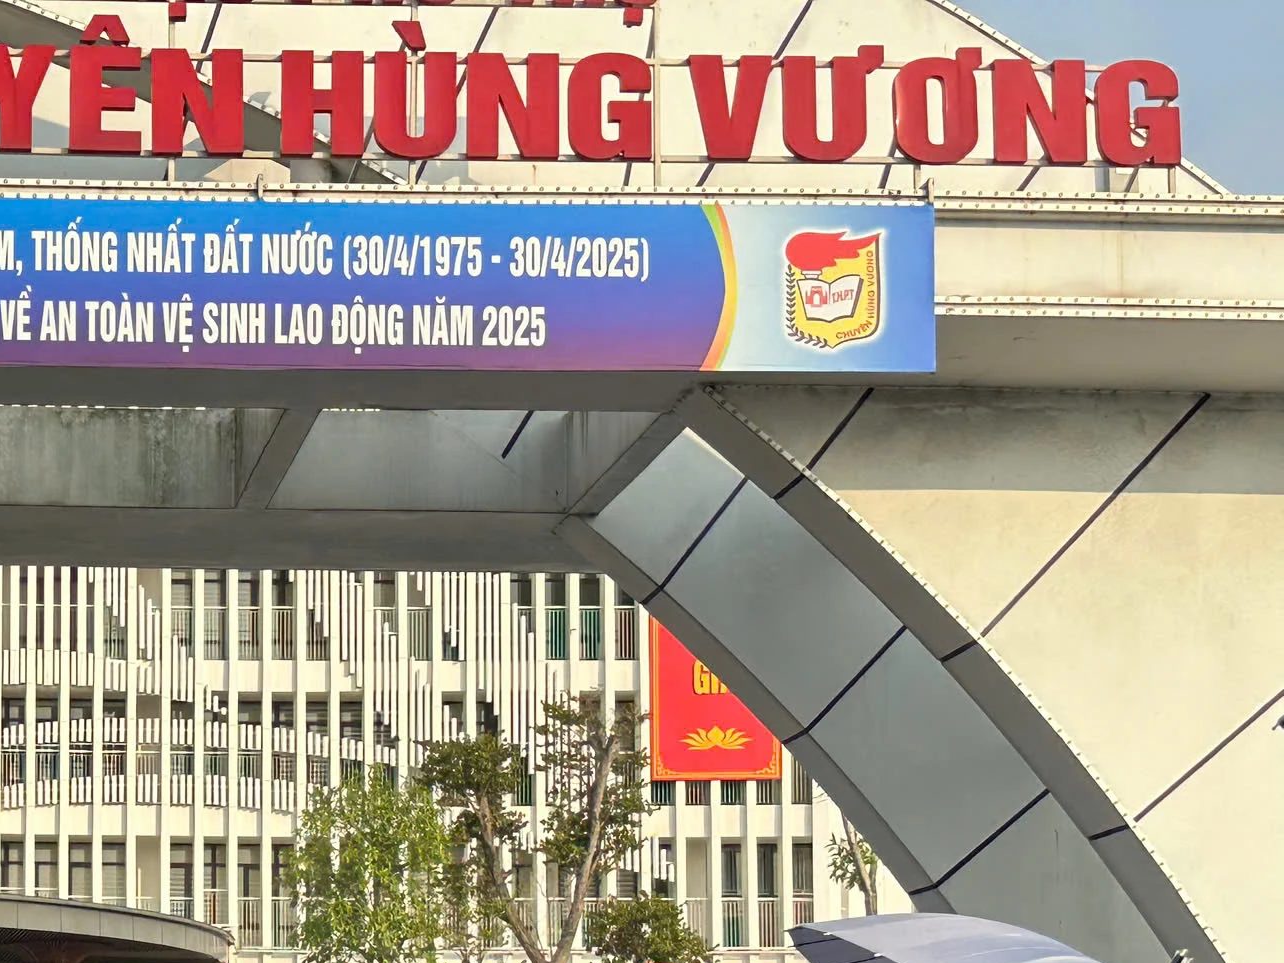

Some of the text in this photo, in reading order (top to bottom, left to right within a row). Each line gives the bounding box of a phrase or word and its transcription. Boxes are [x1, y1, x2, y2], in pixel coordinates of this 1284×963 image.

[279, 20, 653, 161] HÙNG
[687, 44, 1183, 167] VƯƠNG
[31, 216, 118, 273] THỐNG
[127, 218, 196, 274] NHẤT
[203, 219, 254, 274] ĐẤT
[261, 222, 333, 276] NƯỚC
[343, 234, 483, 280] (30/4/1975
[509, 236, 649, 282] 30/4/2025)
[0, 285, 32, 341] VỀ
[39, 300, 77, 342] AN
[84, 292, 154, 343] TOÀN
[162, 293, 194, 353] VỆ
[202, 302, 266, 344] SINH
[274, 303, 323, 345] LAO
[331, 295, 404, 355] ĐỘNG
[412, 295, 474, 346] NĂM
[481, 305, 546, 347] 2025
